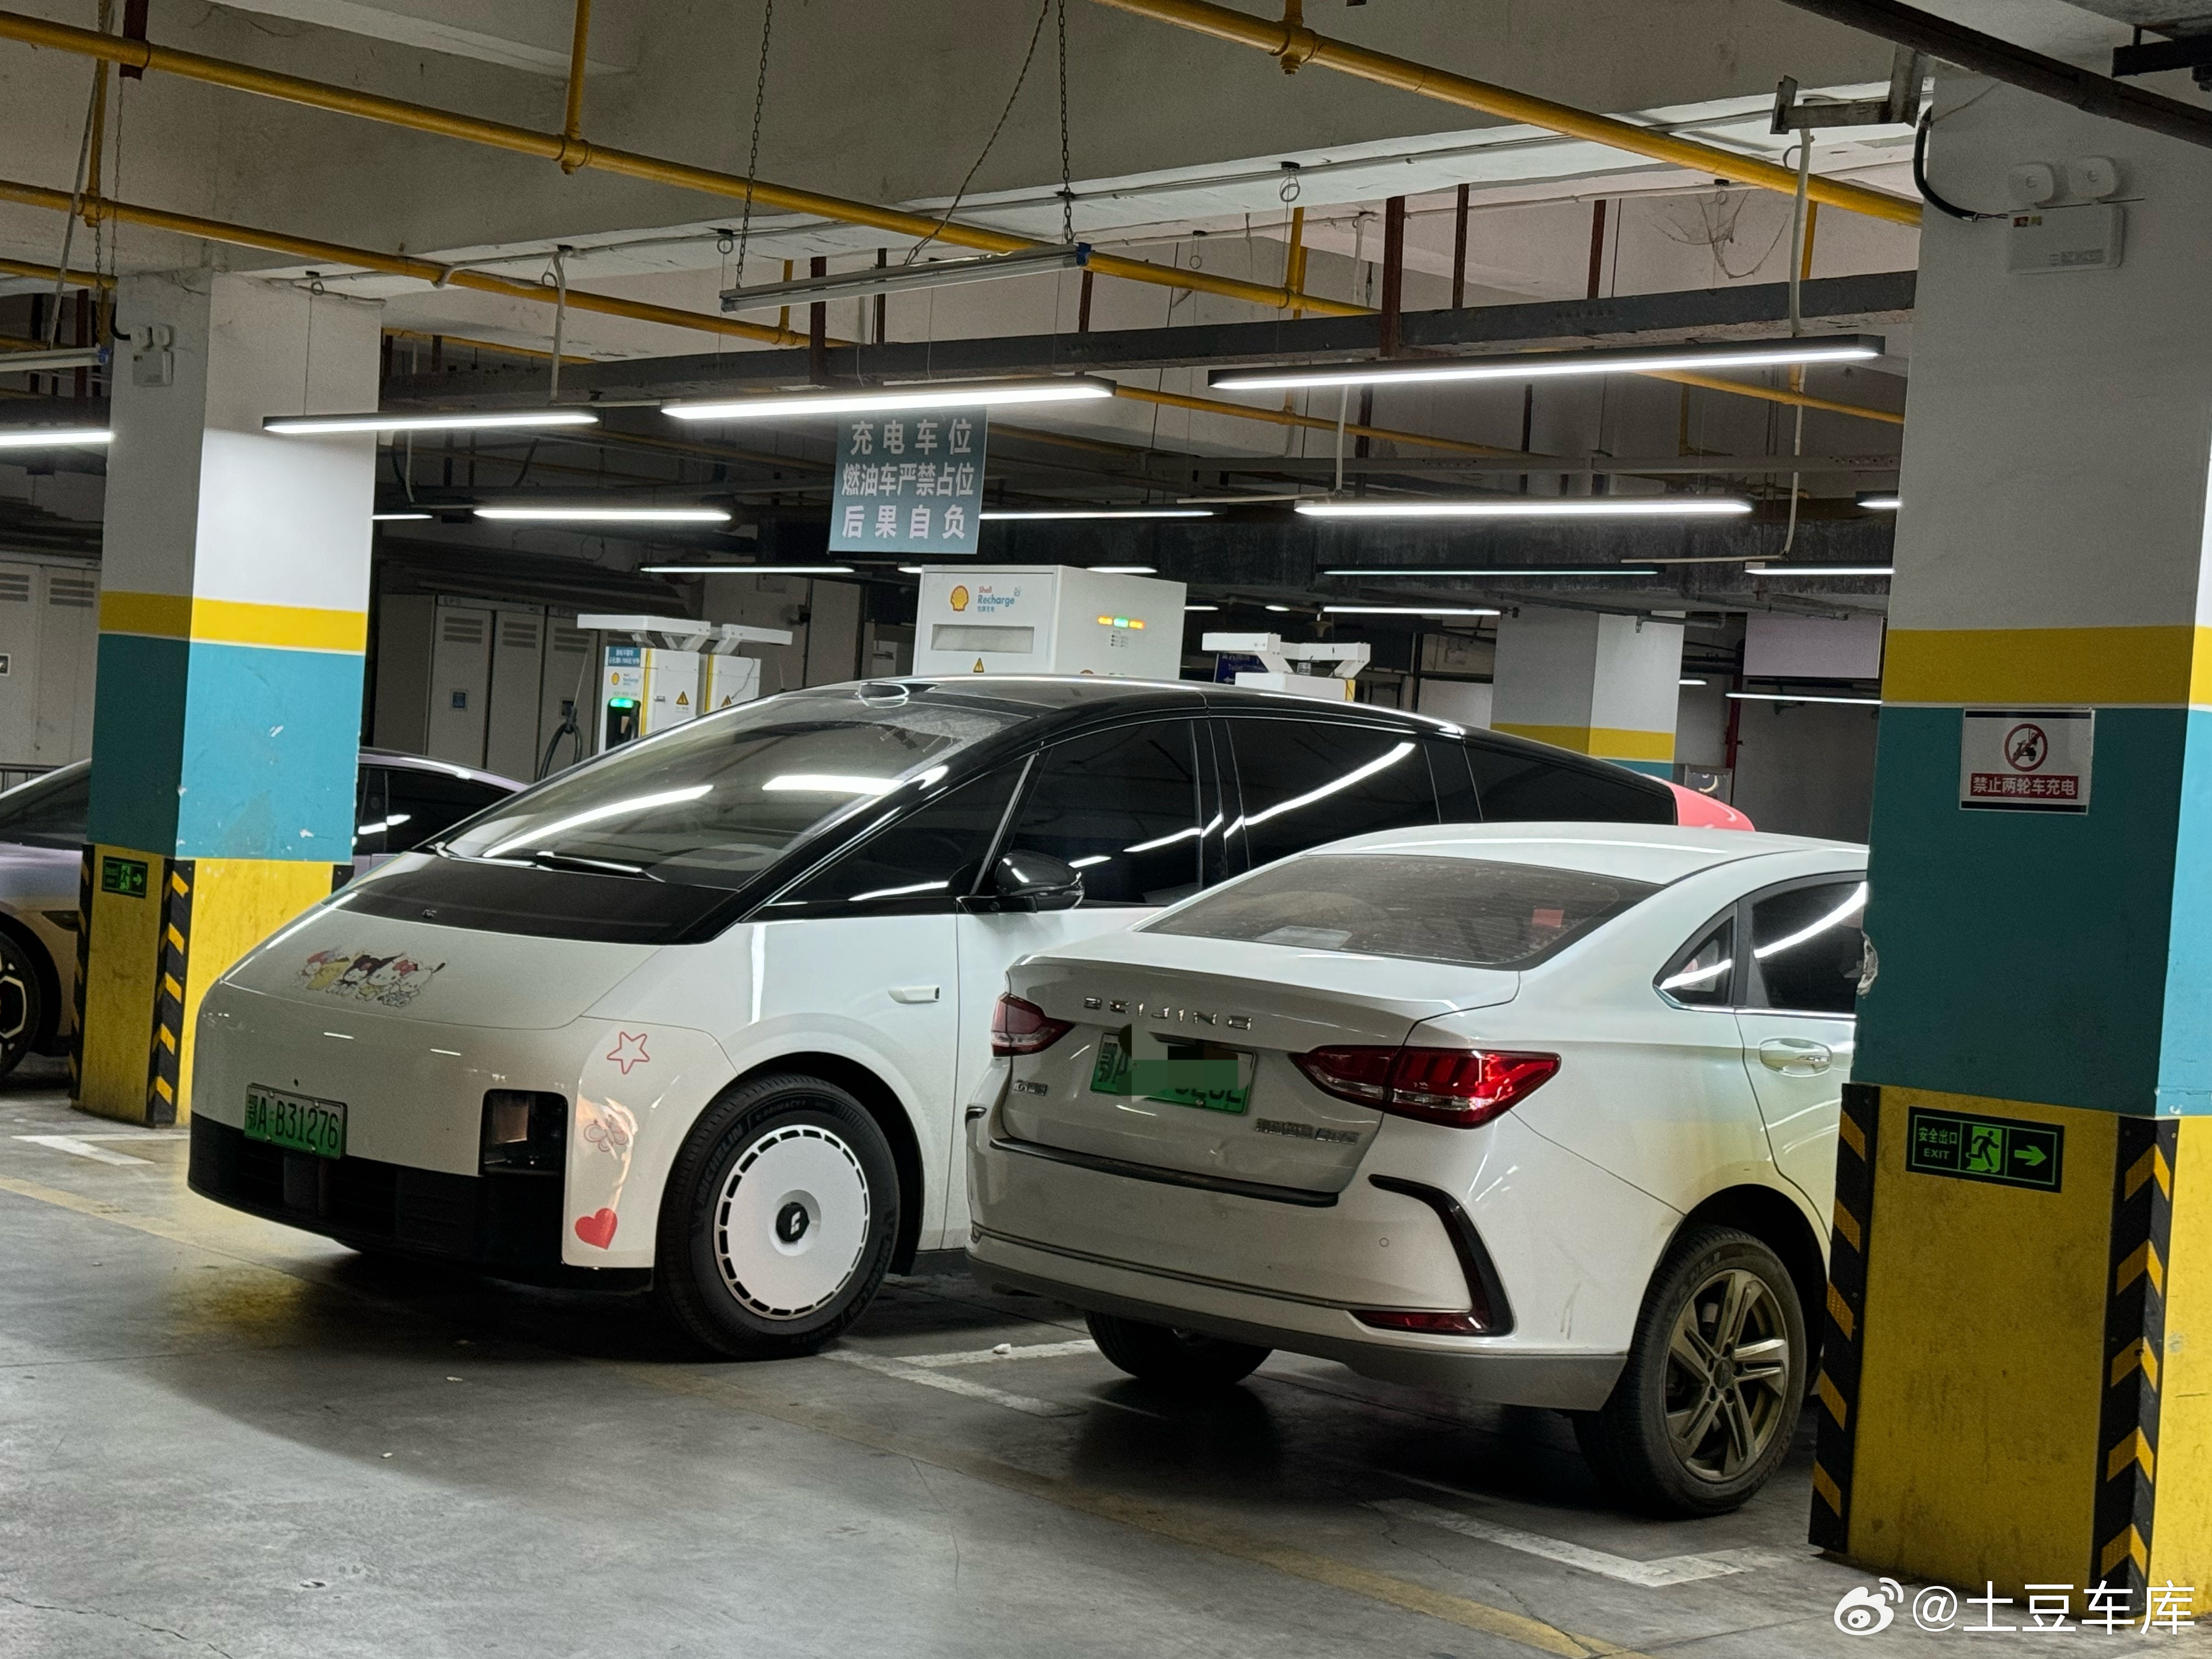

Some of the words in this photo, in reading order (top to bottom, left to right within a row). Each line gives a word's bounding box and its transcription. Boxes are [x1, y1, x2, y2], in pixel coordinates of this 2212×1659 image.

[850, 419, 972, 455] 充电车位
[842, 462, 974, 496] 燃油车严禁占位
[842, 504, 965, 539] 后果自负
[978, 594, 1015, 607] Recharge
[1973, 777, 2075, 795] 禁止两轮车充电
[1084, 996, 1252, 1031] BEIJING
[1918, 1127, 1957, 1145] 安全出口
[1923, 1148, 1950, 1160] EXIT
